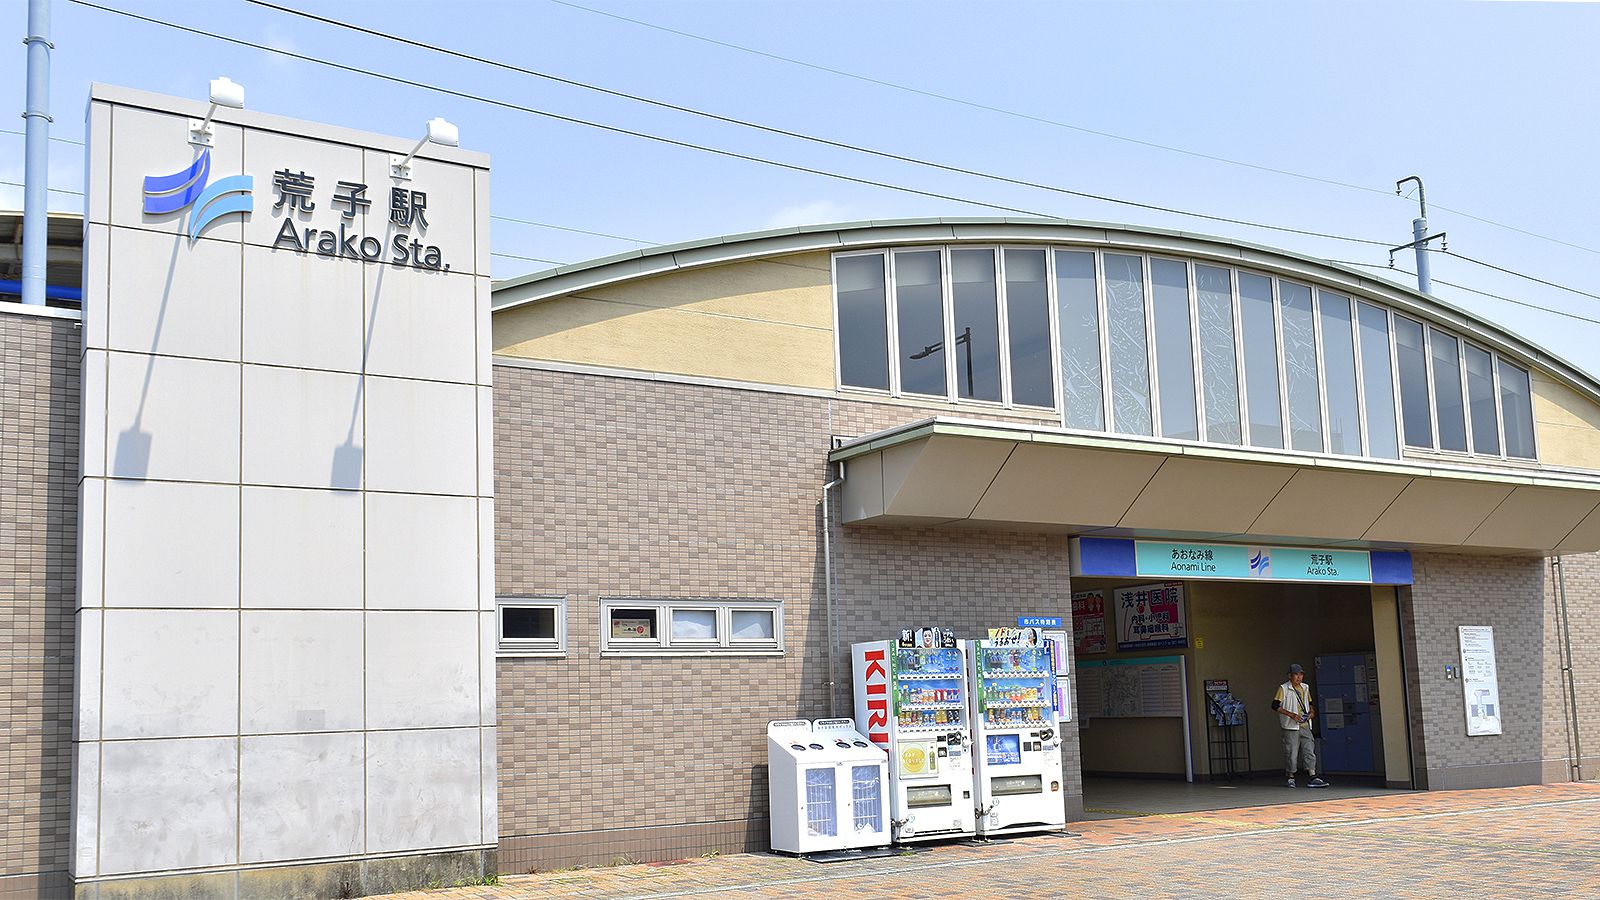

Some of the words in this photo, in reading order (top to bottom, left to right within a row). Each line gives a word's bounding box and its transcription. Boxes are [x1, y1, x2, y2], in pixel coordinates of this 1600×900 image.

[273, 168, 428, 228] 荒子駅
[273, 217, 382, 261] Arako
[392, 233, 450, 271] Sta.
[1171, 549, 1214, 561] あおなみ線
[1310, 554, 1334, 565] 荒子駅
[1171, 562, 1200, 571] Aonami
[1201, 562, 1216, 572] Line
[1306, 566, 1327, 576] Arako
[1121, 587, 1178, 608] 浅井医院
[864, 650, 889, 752] KIRI
